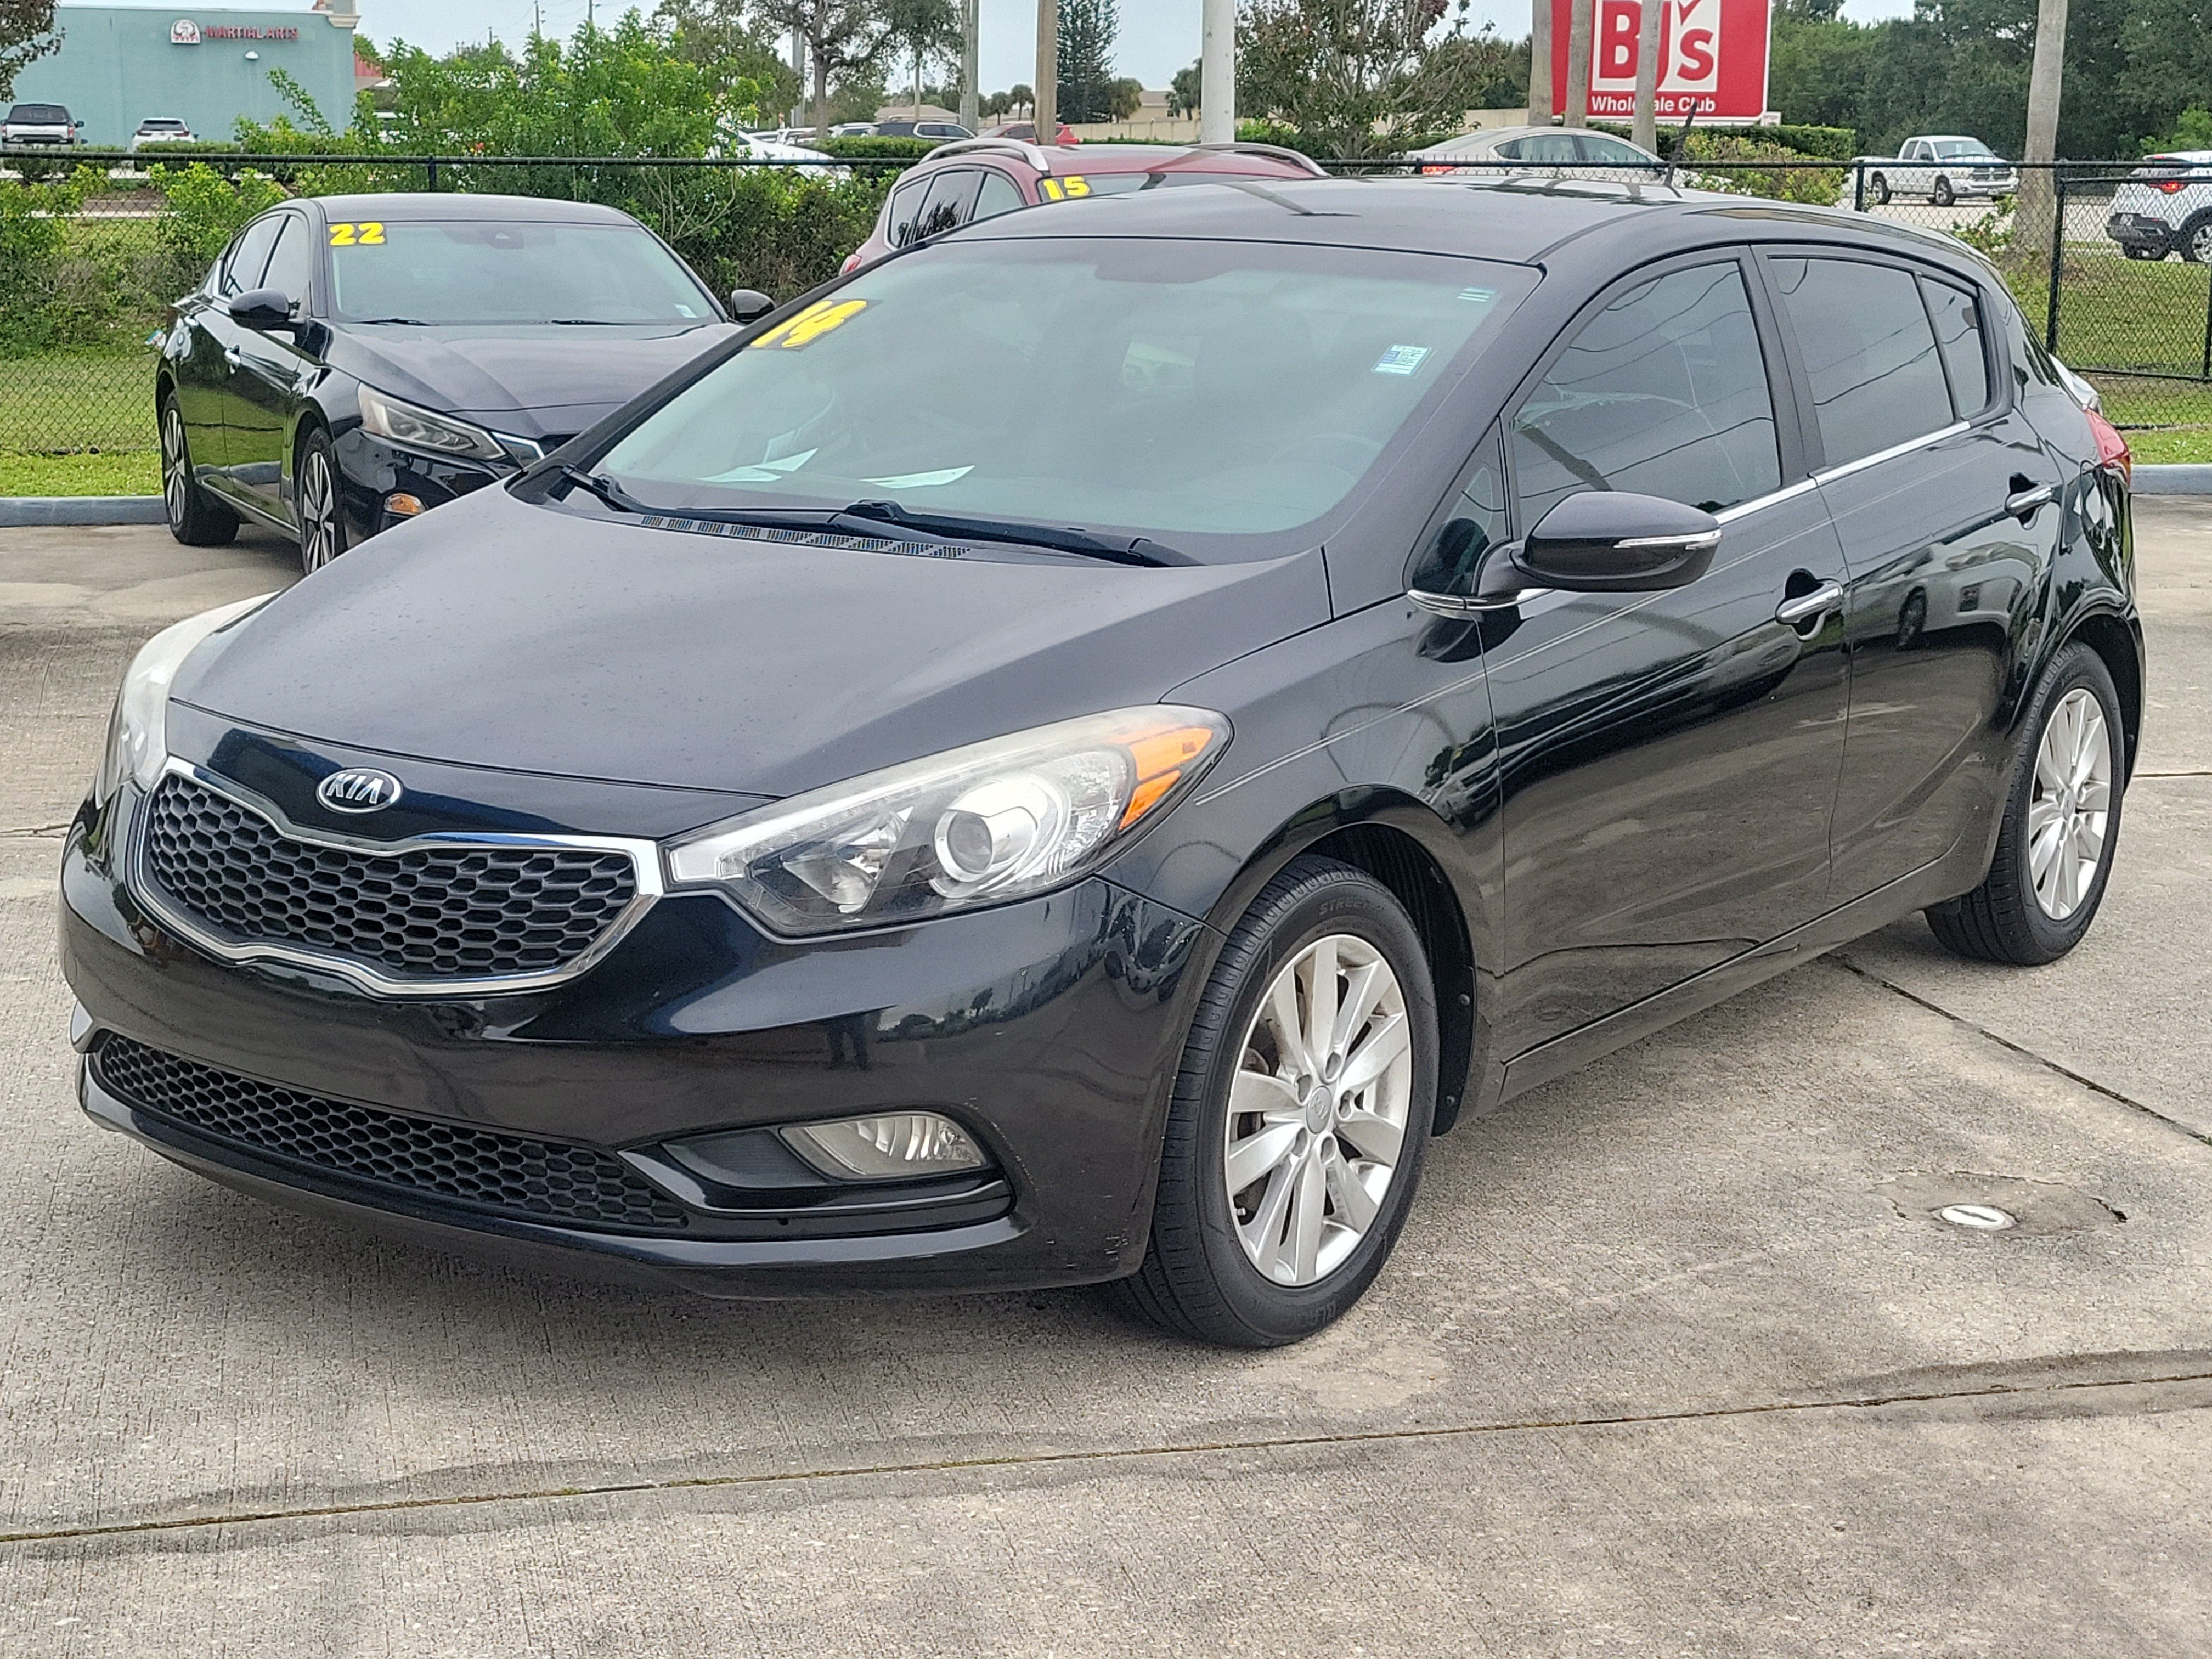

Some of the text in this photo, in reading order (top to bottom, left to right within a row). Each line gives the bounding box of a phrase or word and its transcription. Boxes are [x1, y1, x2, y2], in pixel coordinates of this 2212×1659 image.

[205, 26, 264, 39] MARTIAL
[267, 27, 299, 40] ARTS
[1592, 96, 1675, 112] Wholale
[1043, 176, 1090, 200] 15
[330, 222, 386, 246] 22
[750, 300, 867, 348] 14
[326, 774, 384, 804] KIA
